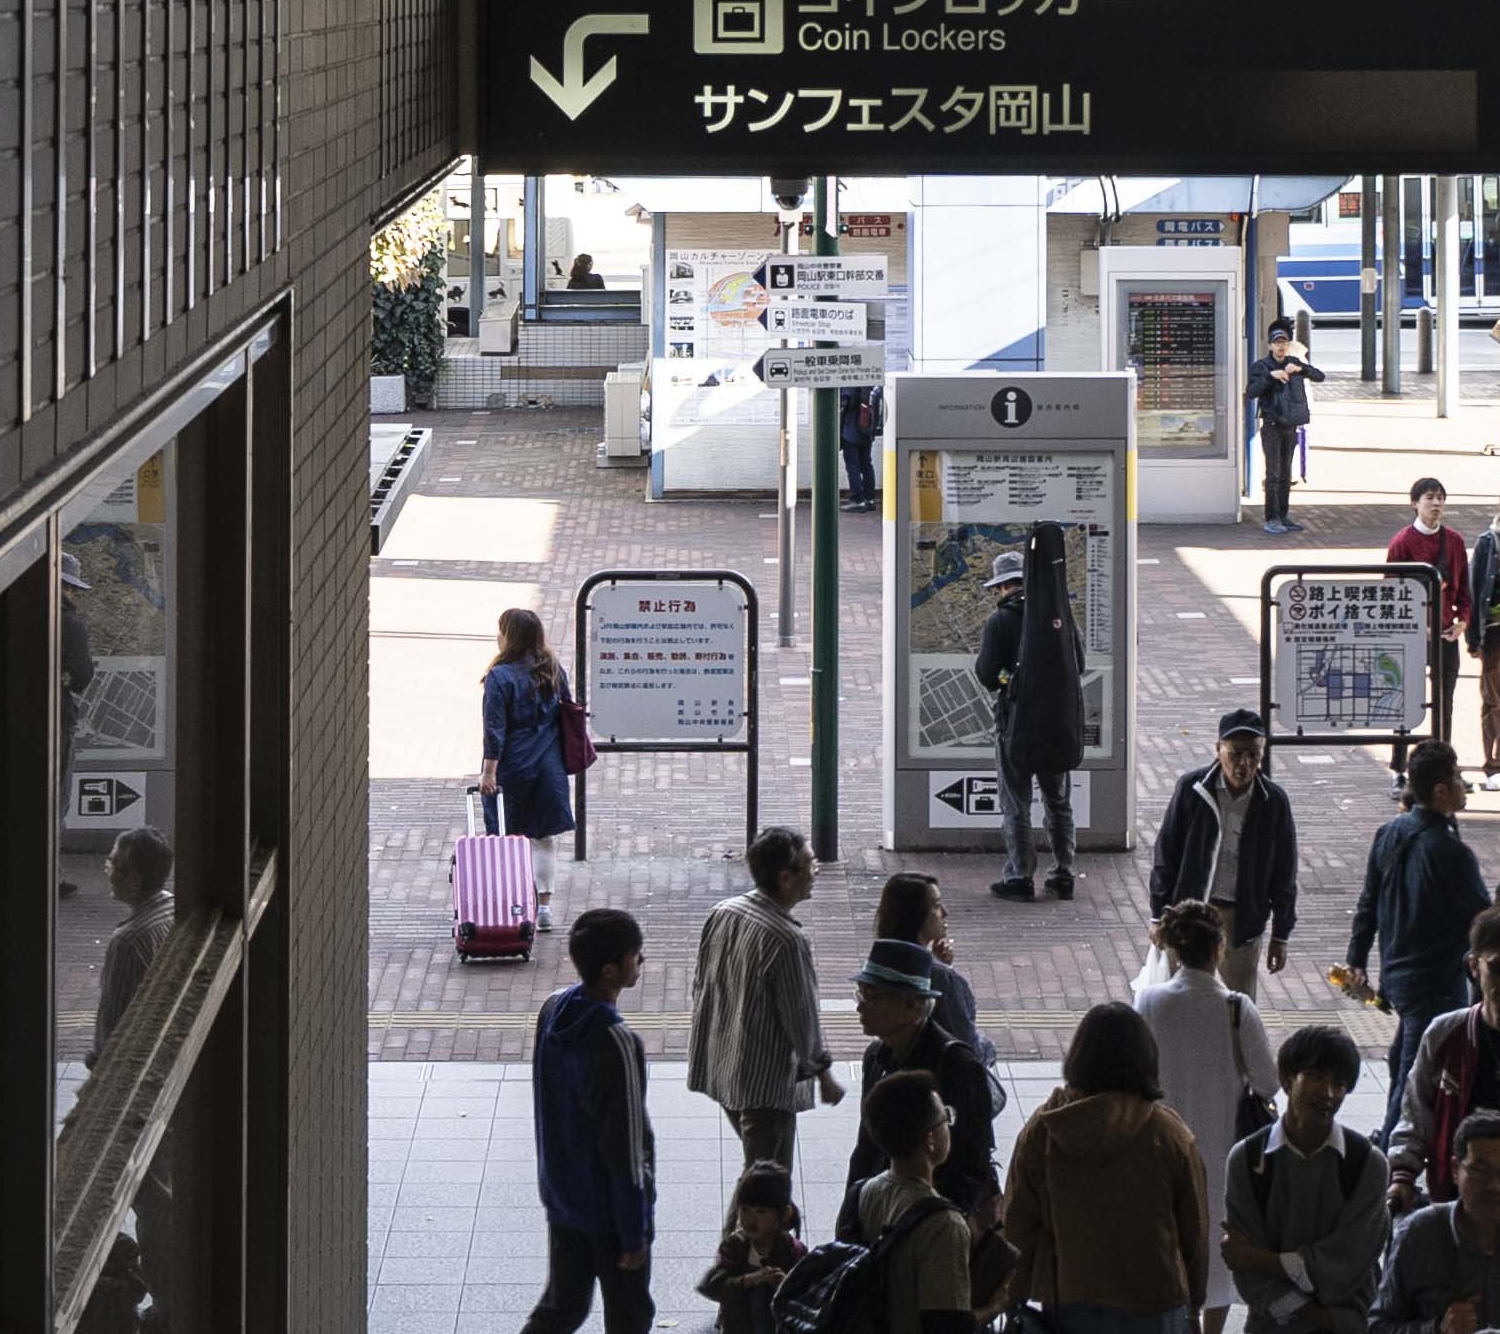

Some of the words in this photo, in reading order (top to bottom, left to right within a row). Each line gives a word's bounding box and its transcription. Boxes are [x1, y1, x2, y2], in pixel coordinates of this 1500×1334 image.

[798, 23, 870, 51] Coin
[883, 23, 1007, 51] Lockers
[694, 84, 1093, 136] サンフェスタ岡山
[1308, 586, 1413, 602] 路上喫煙禁止
[638, 600, 697, 613] 禁止行為
